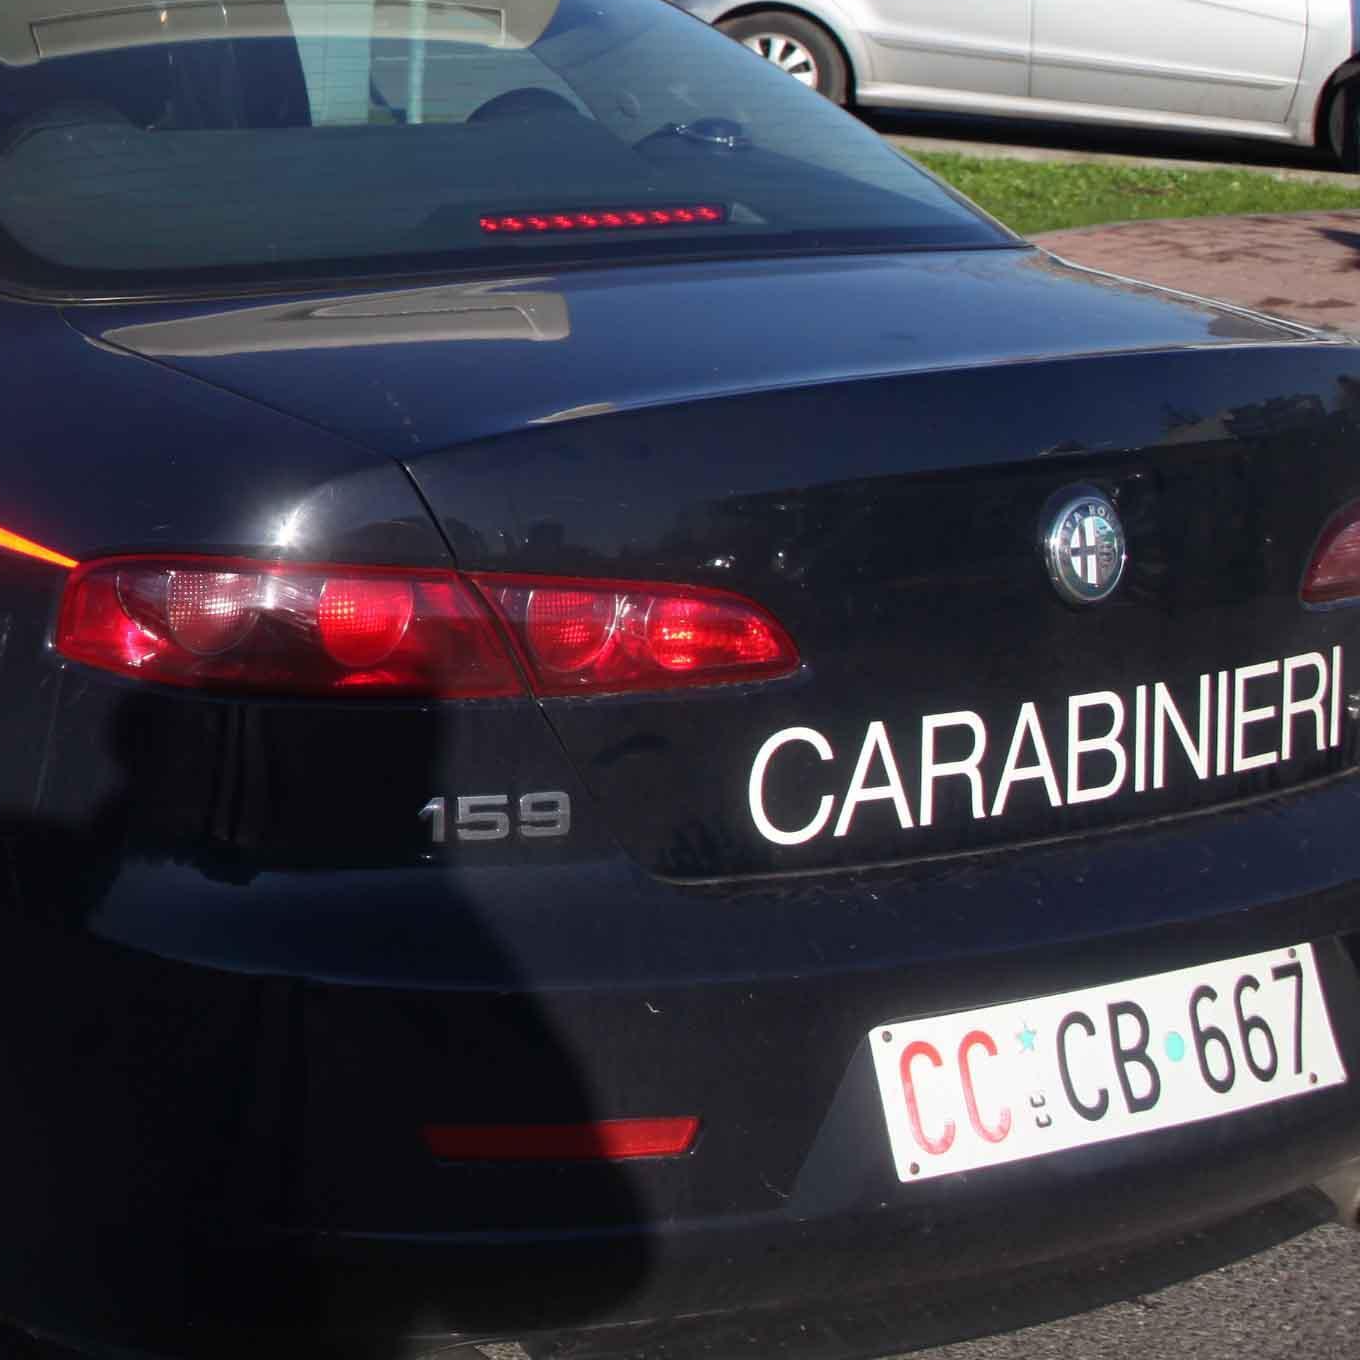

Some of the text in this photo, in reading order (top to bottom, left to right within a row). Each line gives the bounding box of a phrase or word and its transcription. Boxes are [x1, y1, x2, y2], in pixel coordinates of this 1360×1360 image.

[417, 791, 571, 842] 159
[748, 645, 1343, 846] CARABINIERI
[899, 961, 1304, 1155] CC CB 667
